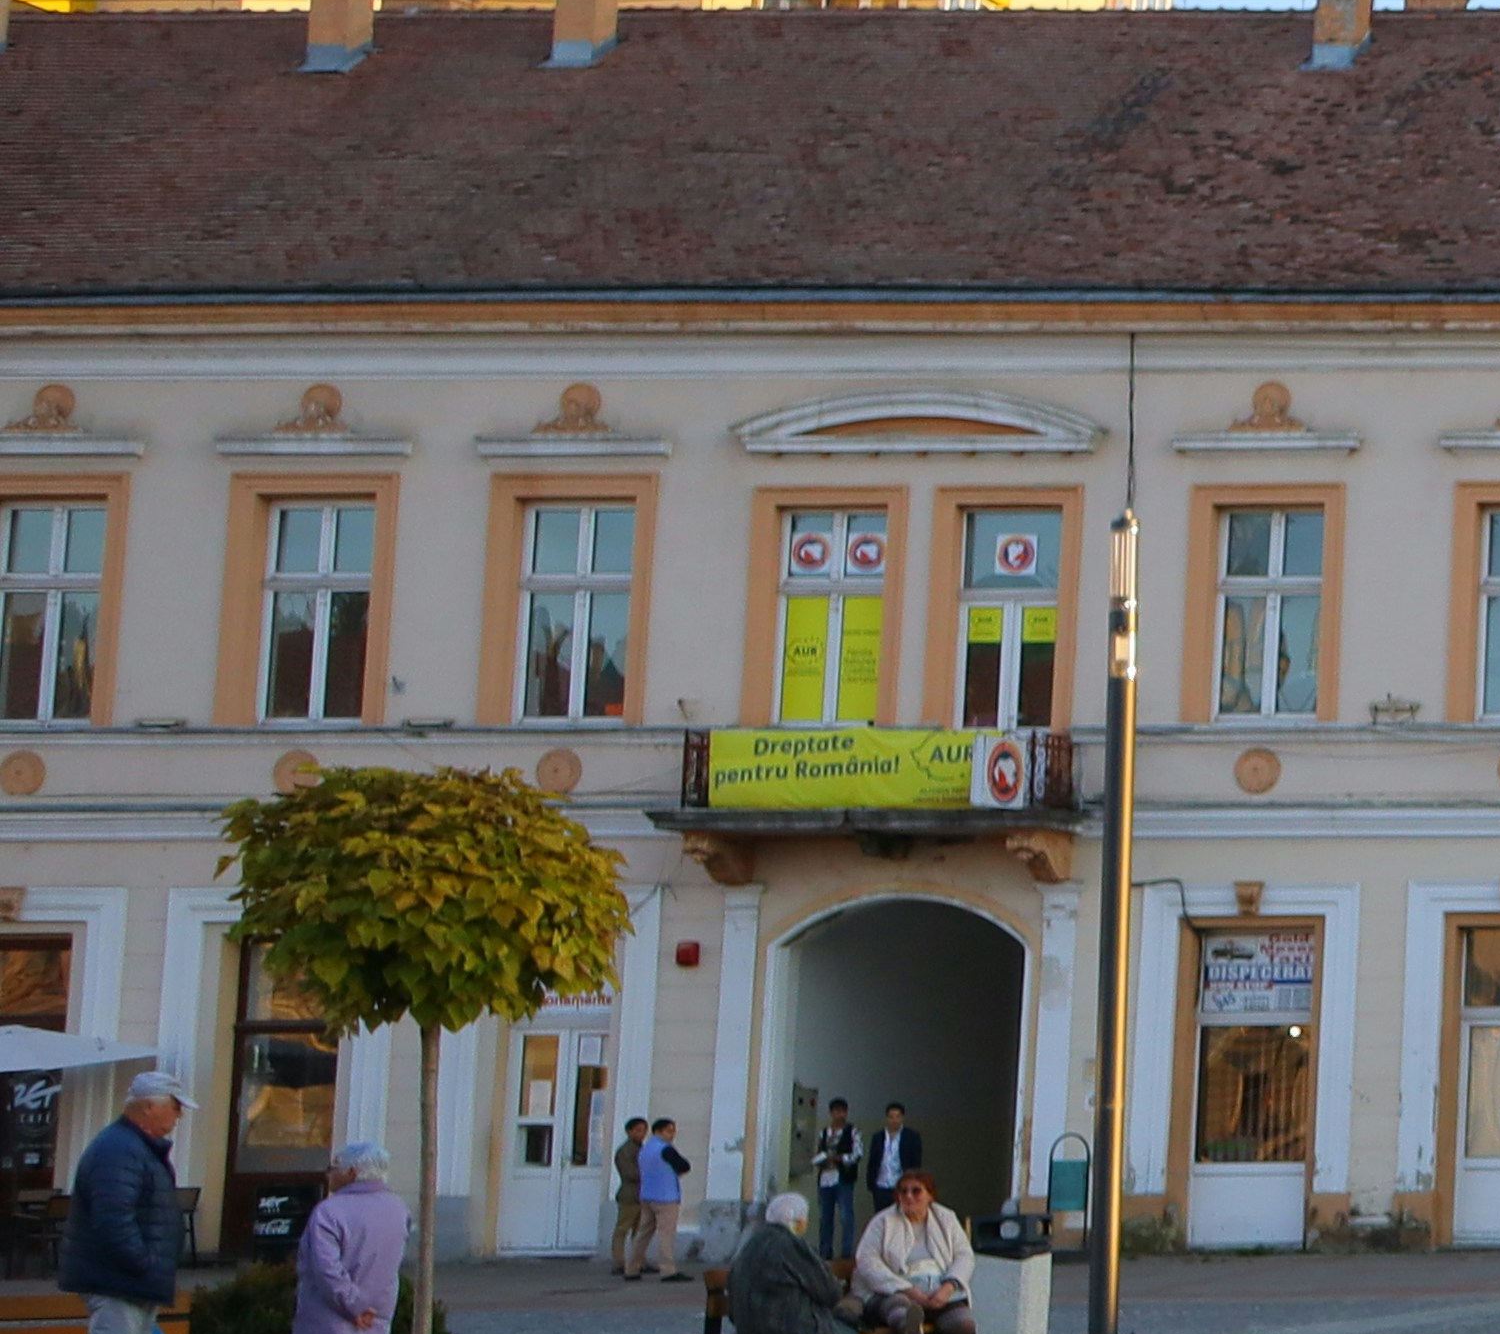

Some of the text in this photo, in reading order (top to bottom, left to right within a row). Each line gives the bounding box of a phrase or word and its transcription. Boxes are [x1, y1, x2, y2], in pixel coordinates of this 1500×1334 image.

[793, 646, 818, 658] AUR
[753, 735, 855, 760] Dreptate
[714, 754, 901, 789] pentru România!
